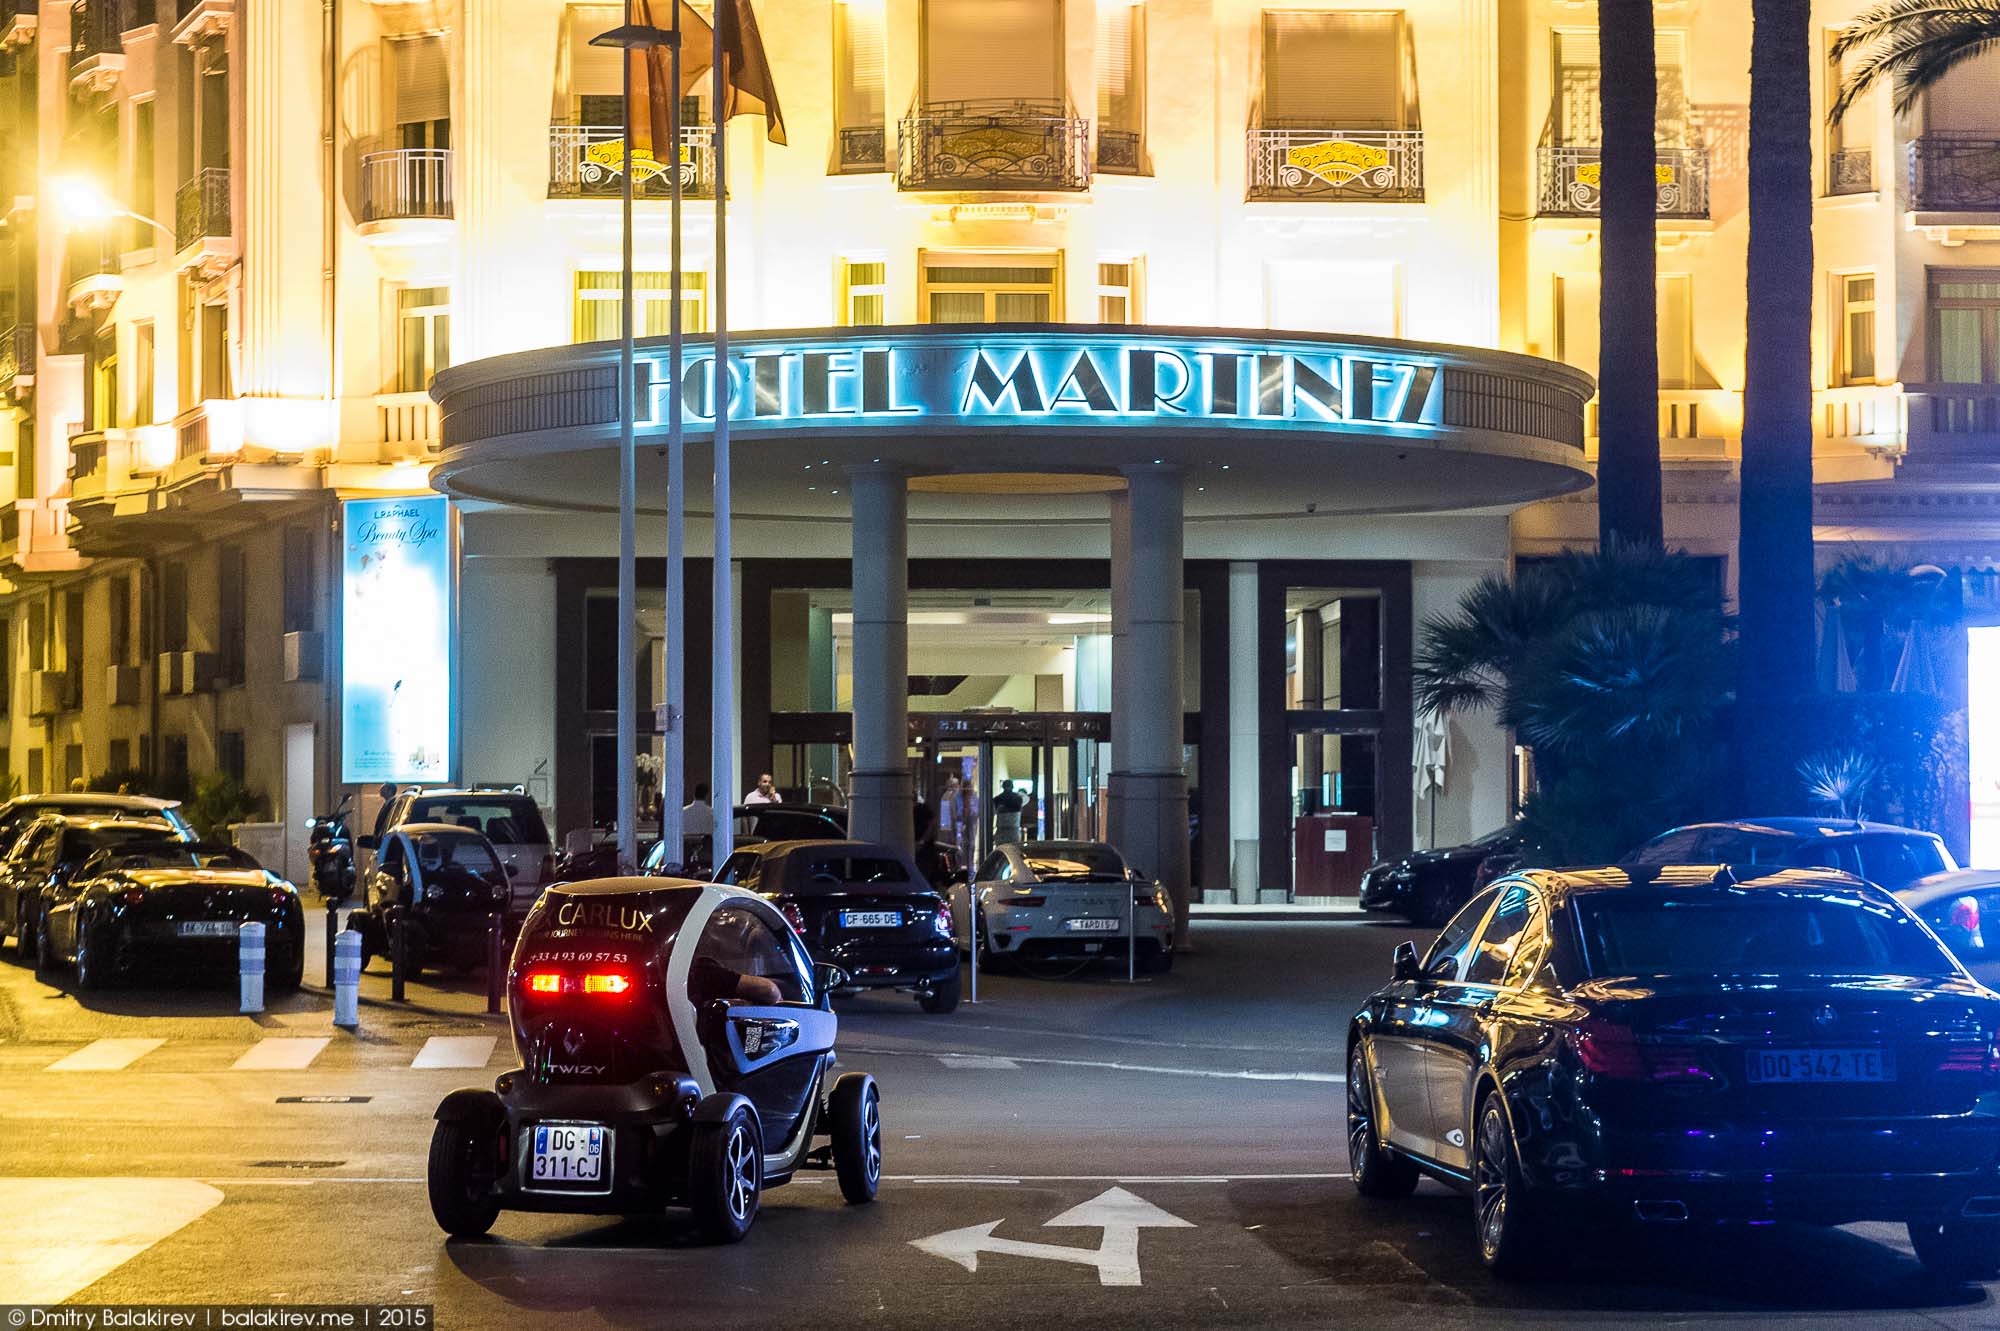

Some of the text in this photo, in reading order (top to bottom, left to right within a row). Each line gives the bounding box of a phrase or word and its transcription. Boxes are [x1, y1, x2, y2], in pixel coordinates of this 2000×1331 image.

[632, 346, 1438, 426] HOTEL MARTINEZ
[409, 518, 439, 549] Spa
[558, 902, 653, 932] CARLUX
[552, 952, 559, 961] 4
[562, 952, 575, 961] 93
[578, 952, 592, 961] 69
[595, 952, 610, 962] 57
[613, 954, 628, 963] 53
[548, 1064, 605, 1074] TWIZY
[589, 1143, 600, 1154] 06
[535, 1156, 600, 1178] 311-CJ
